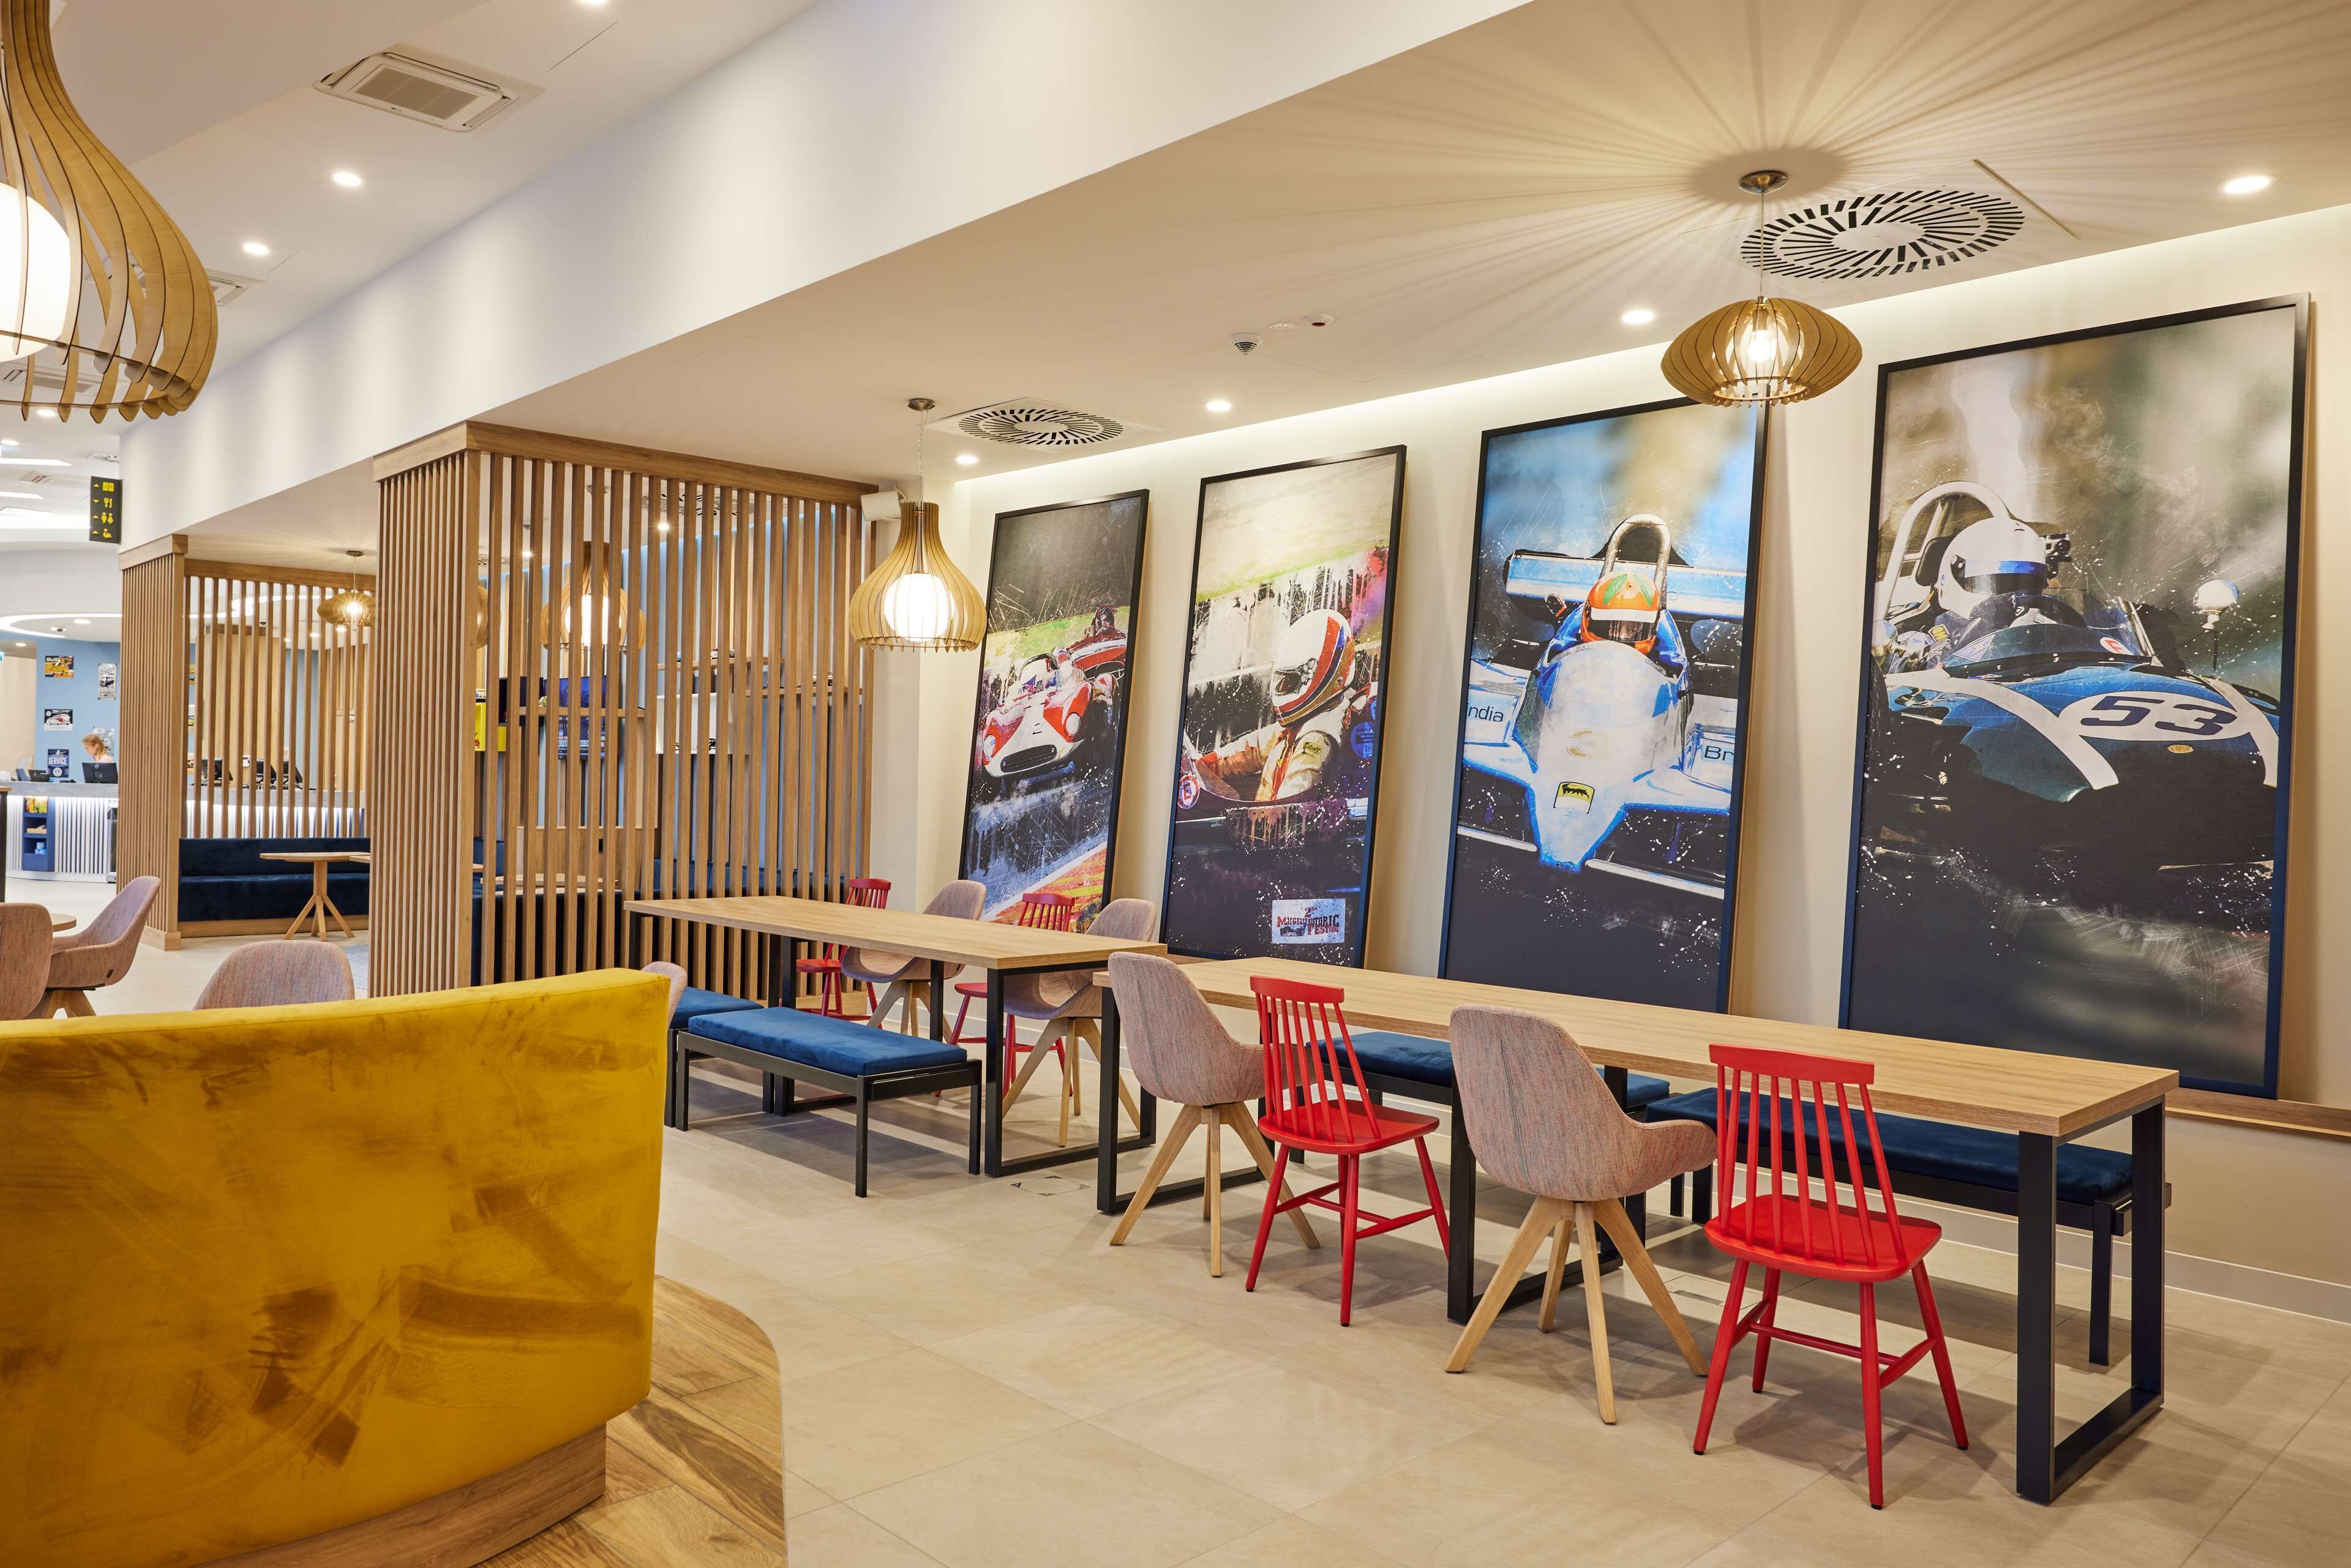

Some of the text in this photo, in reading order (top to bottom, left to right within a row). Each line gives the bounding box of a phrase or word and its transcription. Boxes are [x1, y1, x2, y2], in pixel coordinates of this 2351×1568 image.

[1466, 702, 1504, 722] ndia
[2080, 696, 2238, 736] 53
[1704, 745, 1734, 761] Br
